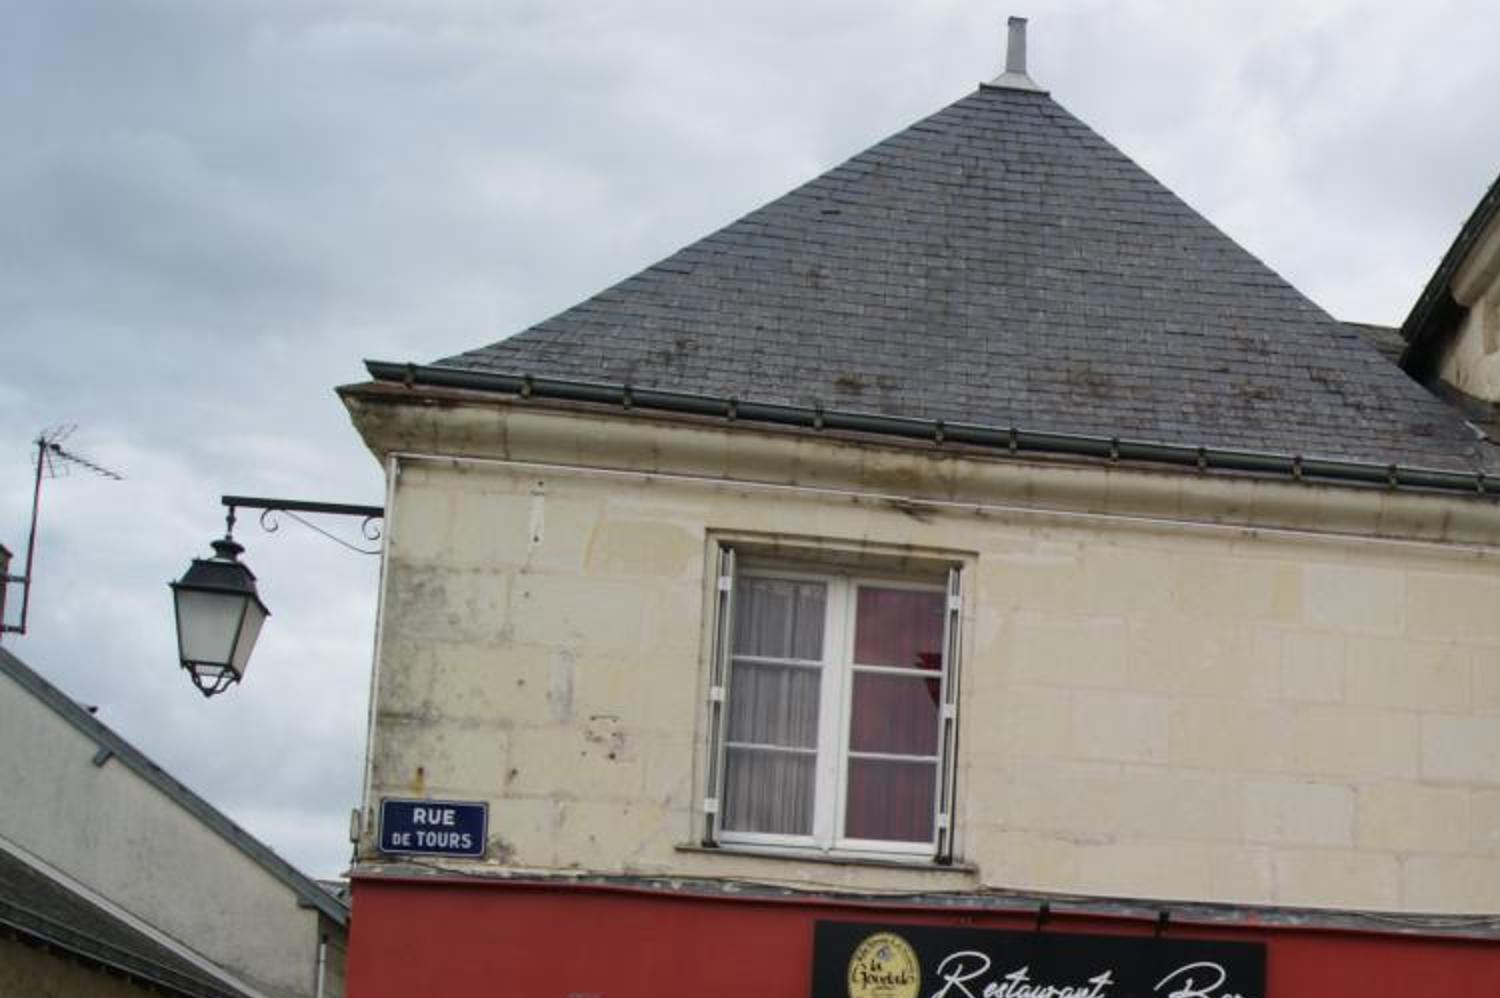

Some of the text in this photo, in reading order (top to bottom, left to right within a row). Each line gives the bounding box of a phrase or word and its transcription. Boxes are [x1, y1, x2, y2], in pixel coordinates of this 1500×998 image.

[413, 807, 456, 825] RUE
[391, 831, 472, 849] DE TOURS
